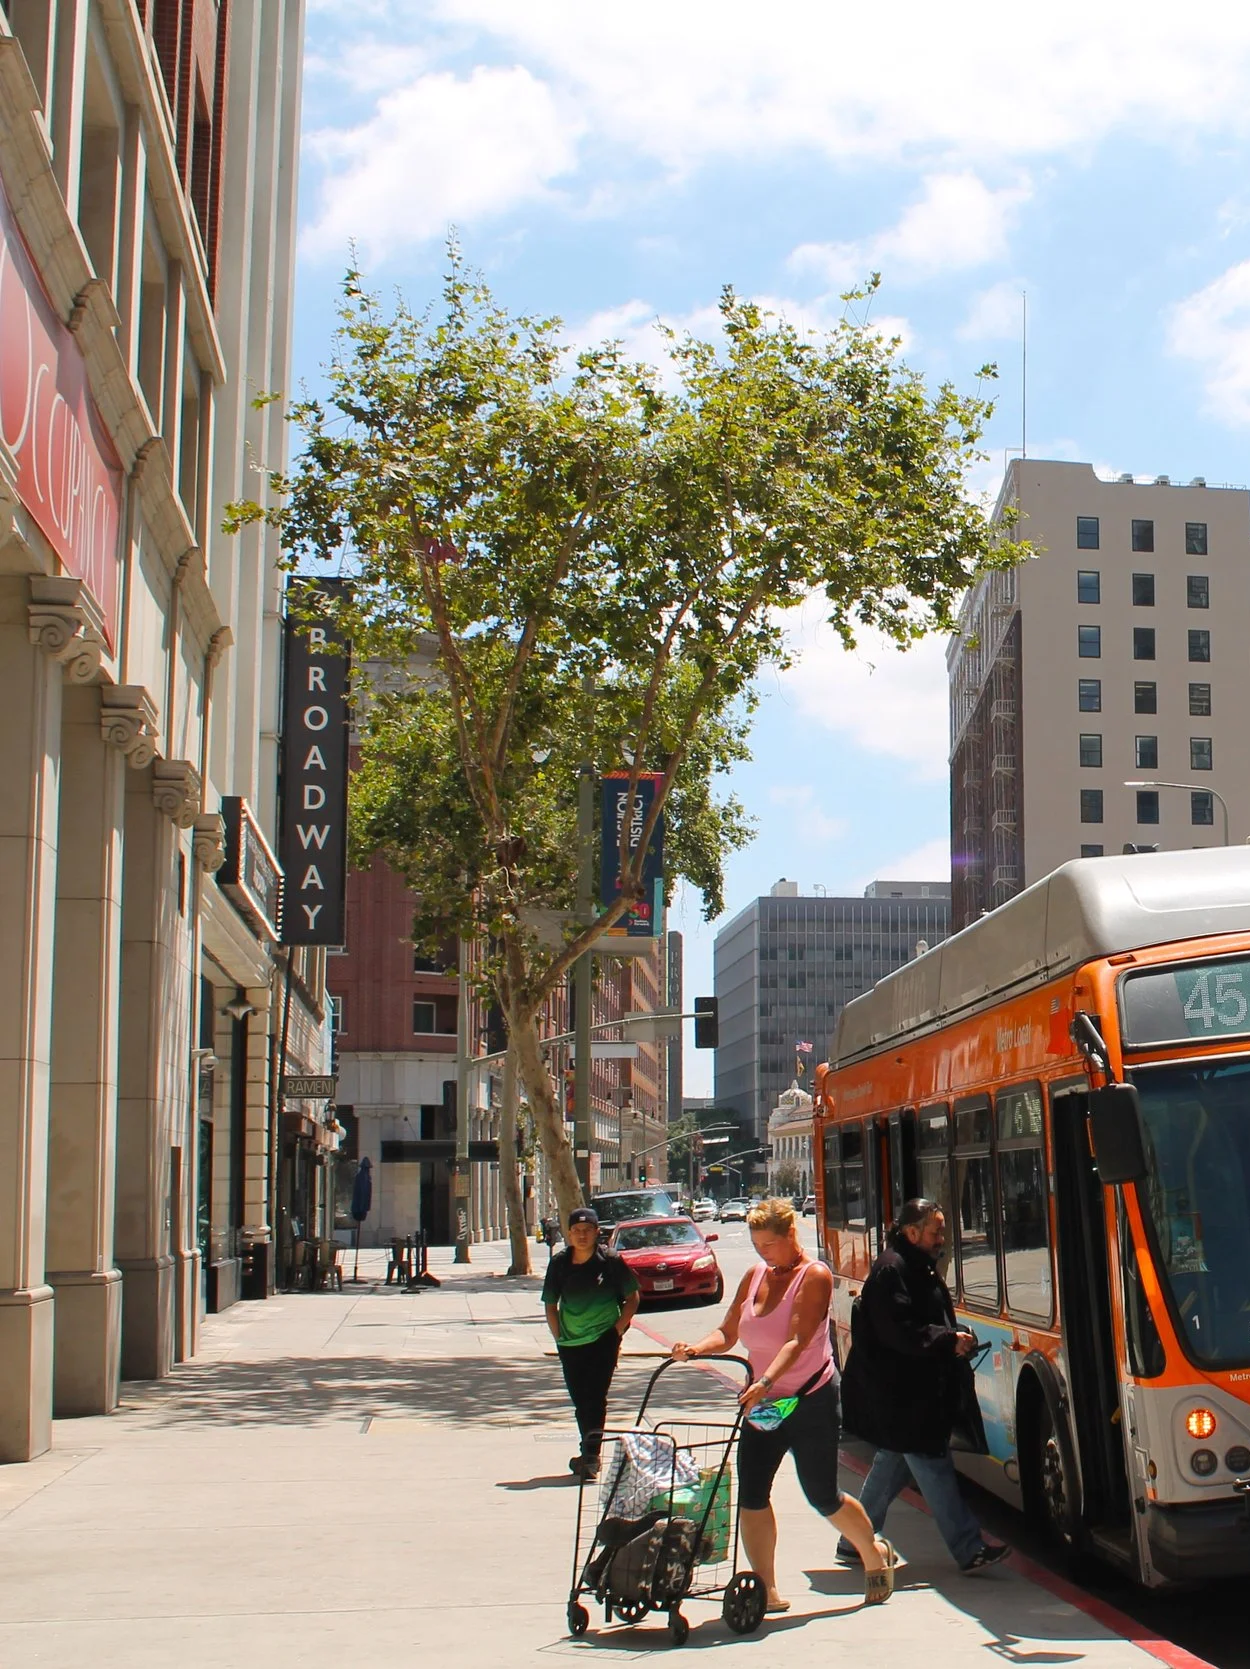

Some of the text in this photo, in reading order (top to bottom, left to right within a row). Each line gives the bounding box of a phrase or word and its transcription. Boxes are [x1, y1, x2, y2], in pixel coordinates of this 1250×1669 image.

[296, 627, 331, 931] BROADWAY
[1183, 973, 1249, 1029] 45
[287, 1081, 330, 1094] RAMEN
